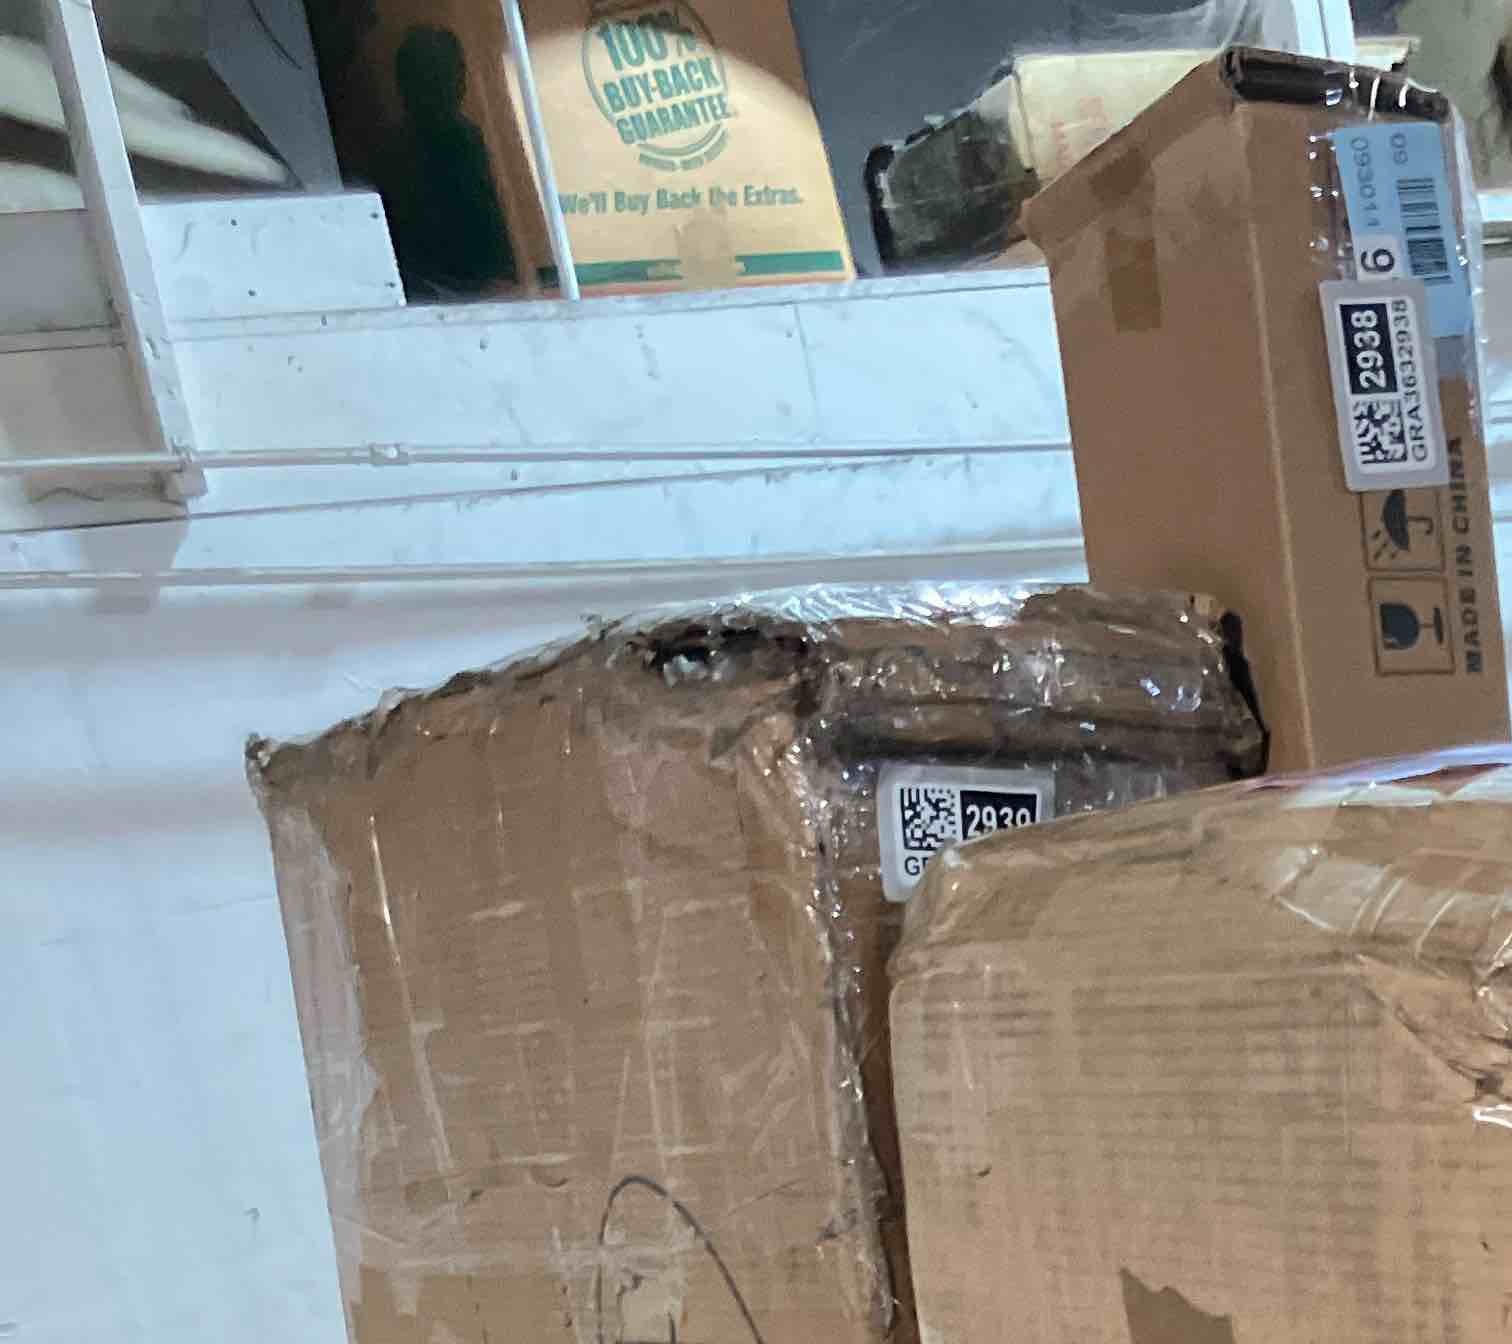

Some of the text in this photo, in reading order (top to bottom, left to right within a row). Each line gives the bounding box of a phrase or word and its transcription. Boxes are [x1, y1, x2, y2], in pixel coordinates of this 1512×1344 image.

[597, 12, 702, 71] 100%
[602, 56, 720, 113] BUY-BACK
[616, 92, 731, 145] GUARANTEE
[615, 191, 650, 215] Buy
[657, 187, 703, 209] Back
[1350, 308, 1388, 390] 2938
[1447, 435, 1483, 674] MADE IN CHINA
